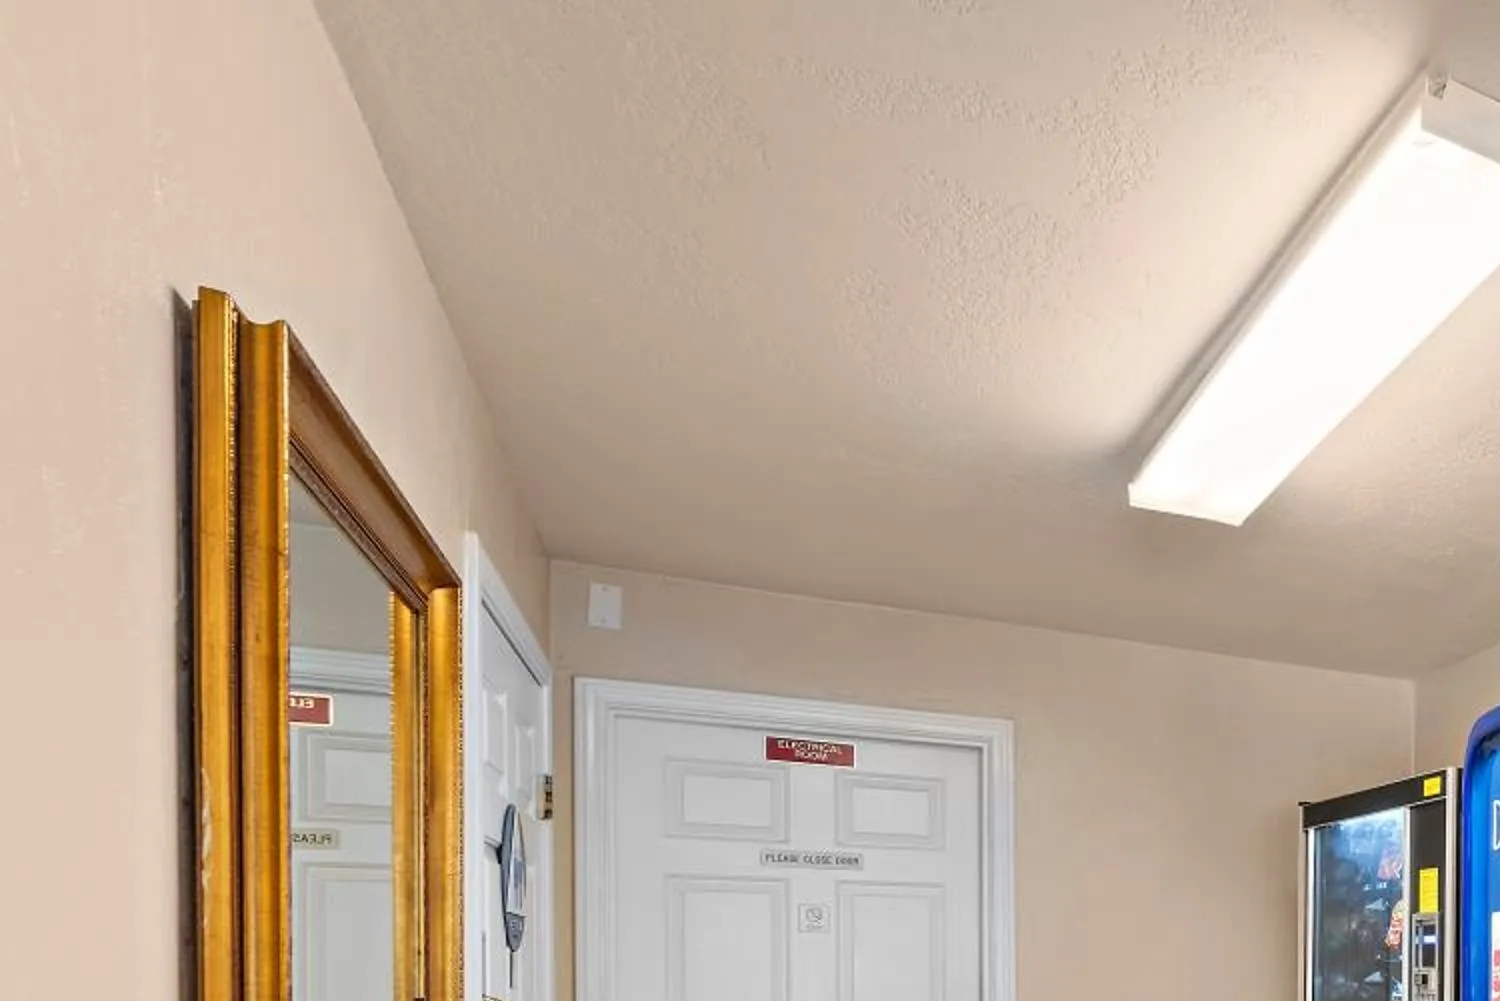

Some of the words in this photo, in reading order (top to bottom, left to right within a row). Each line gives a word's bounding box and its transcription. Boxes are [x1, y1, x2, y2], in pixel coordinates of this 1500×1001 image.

[777, 739, 843, 755] ELECTRICAL
[765, 853, 799, 863] PLEASE
[803, 855, 830, 865] CLOSE
